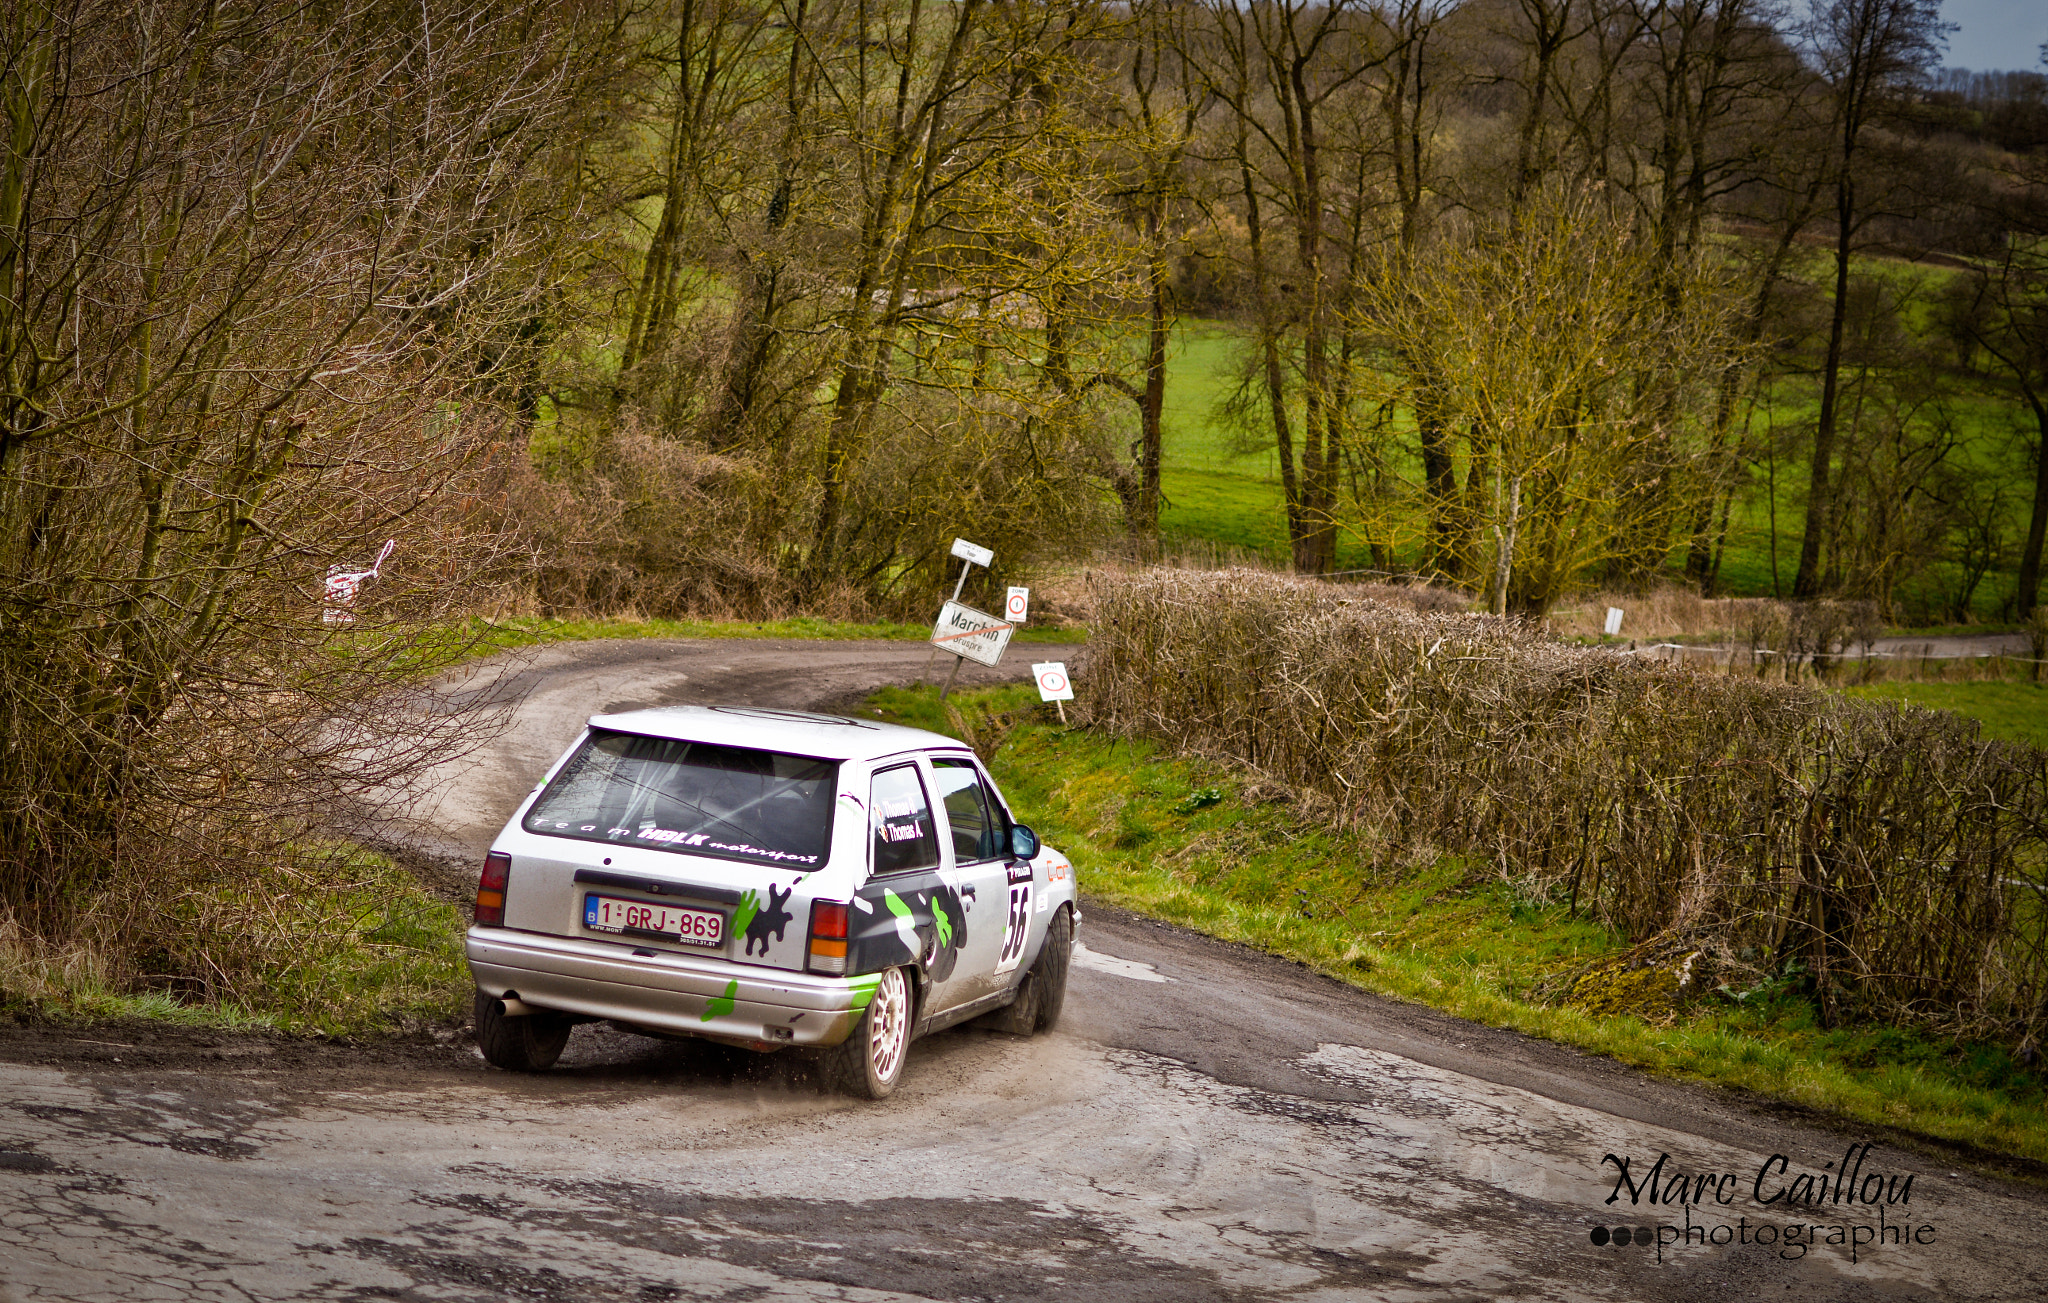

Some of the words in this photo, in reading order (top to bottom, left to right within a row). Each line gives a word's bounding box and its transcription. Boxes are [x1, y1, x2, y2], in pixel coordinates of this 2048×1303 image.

[951, 609, 999, 642] Marchin
[882, 799, 910, 819] Thomas
[637, 827, 711, 846] HBLK
[708, 840, 818, 864] motorsport
[887, 823, 916, 842] Thomas
[588, 911, 596, 922] B
[602, 902, 720, 938] 1-GRJ-869
[1001, 886, 1028, 962] 56
